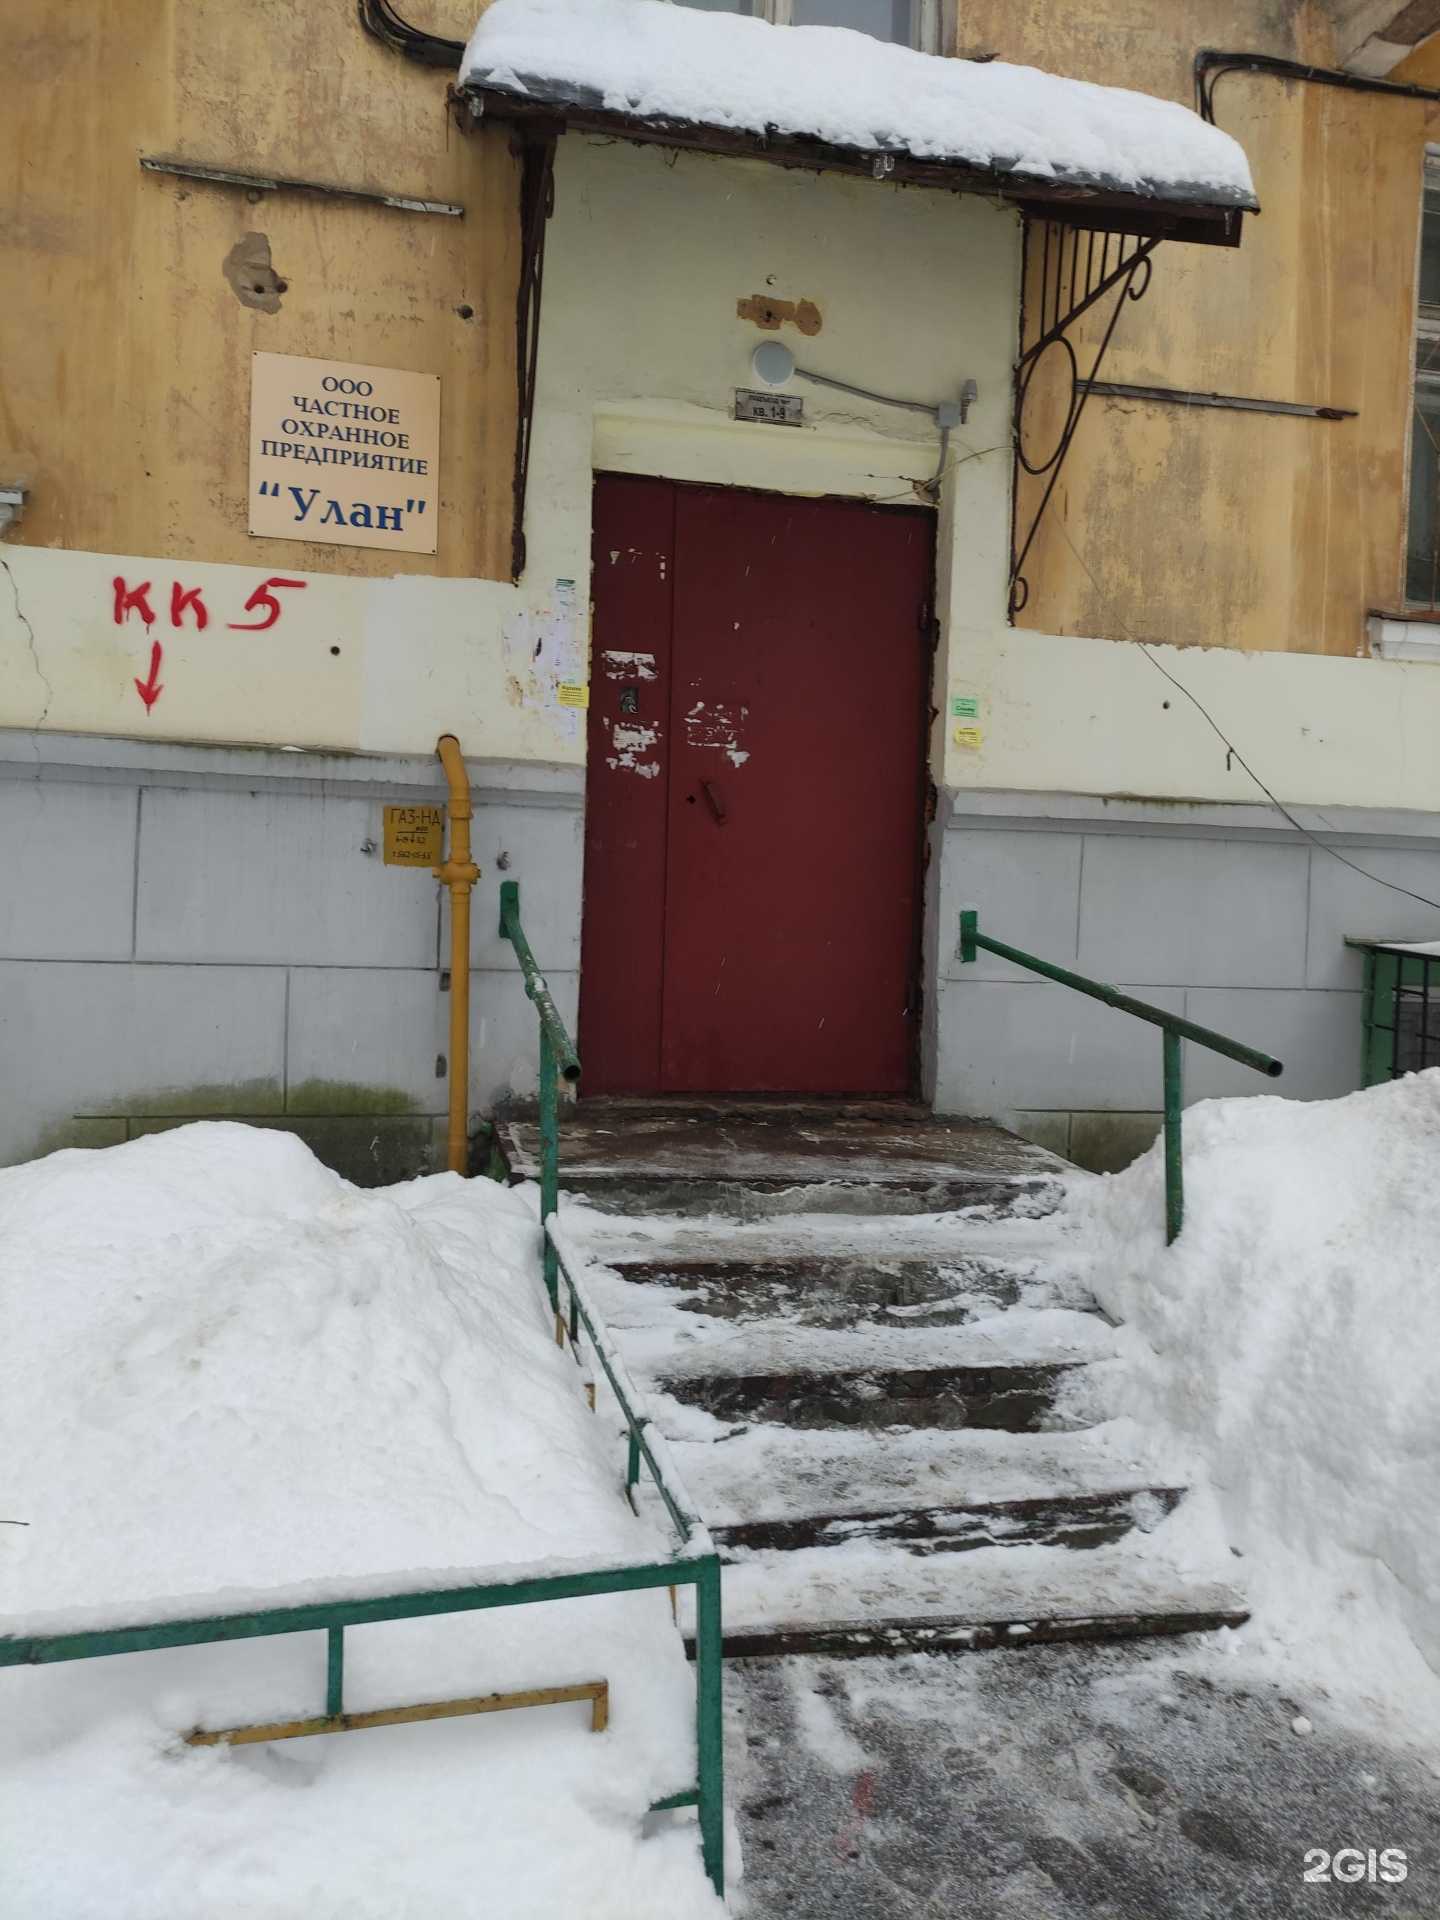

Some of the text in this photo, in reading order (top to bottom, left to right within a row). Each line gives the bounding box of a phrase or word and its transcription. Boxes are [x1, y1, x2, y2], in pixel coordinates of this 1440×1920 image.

[321, 376, 373, 397] ООО
[293, 396, 400, 425] ЧАСТНОЕ
[281, 419, 410, 450] ОХРАННОЕ
[261, 440, 428, 475] ПРЕДПРИЯТИЕ
[259, 481, 426, 531] "Улан"
[227, 577, 307, 630] 5
